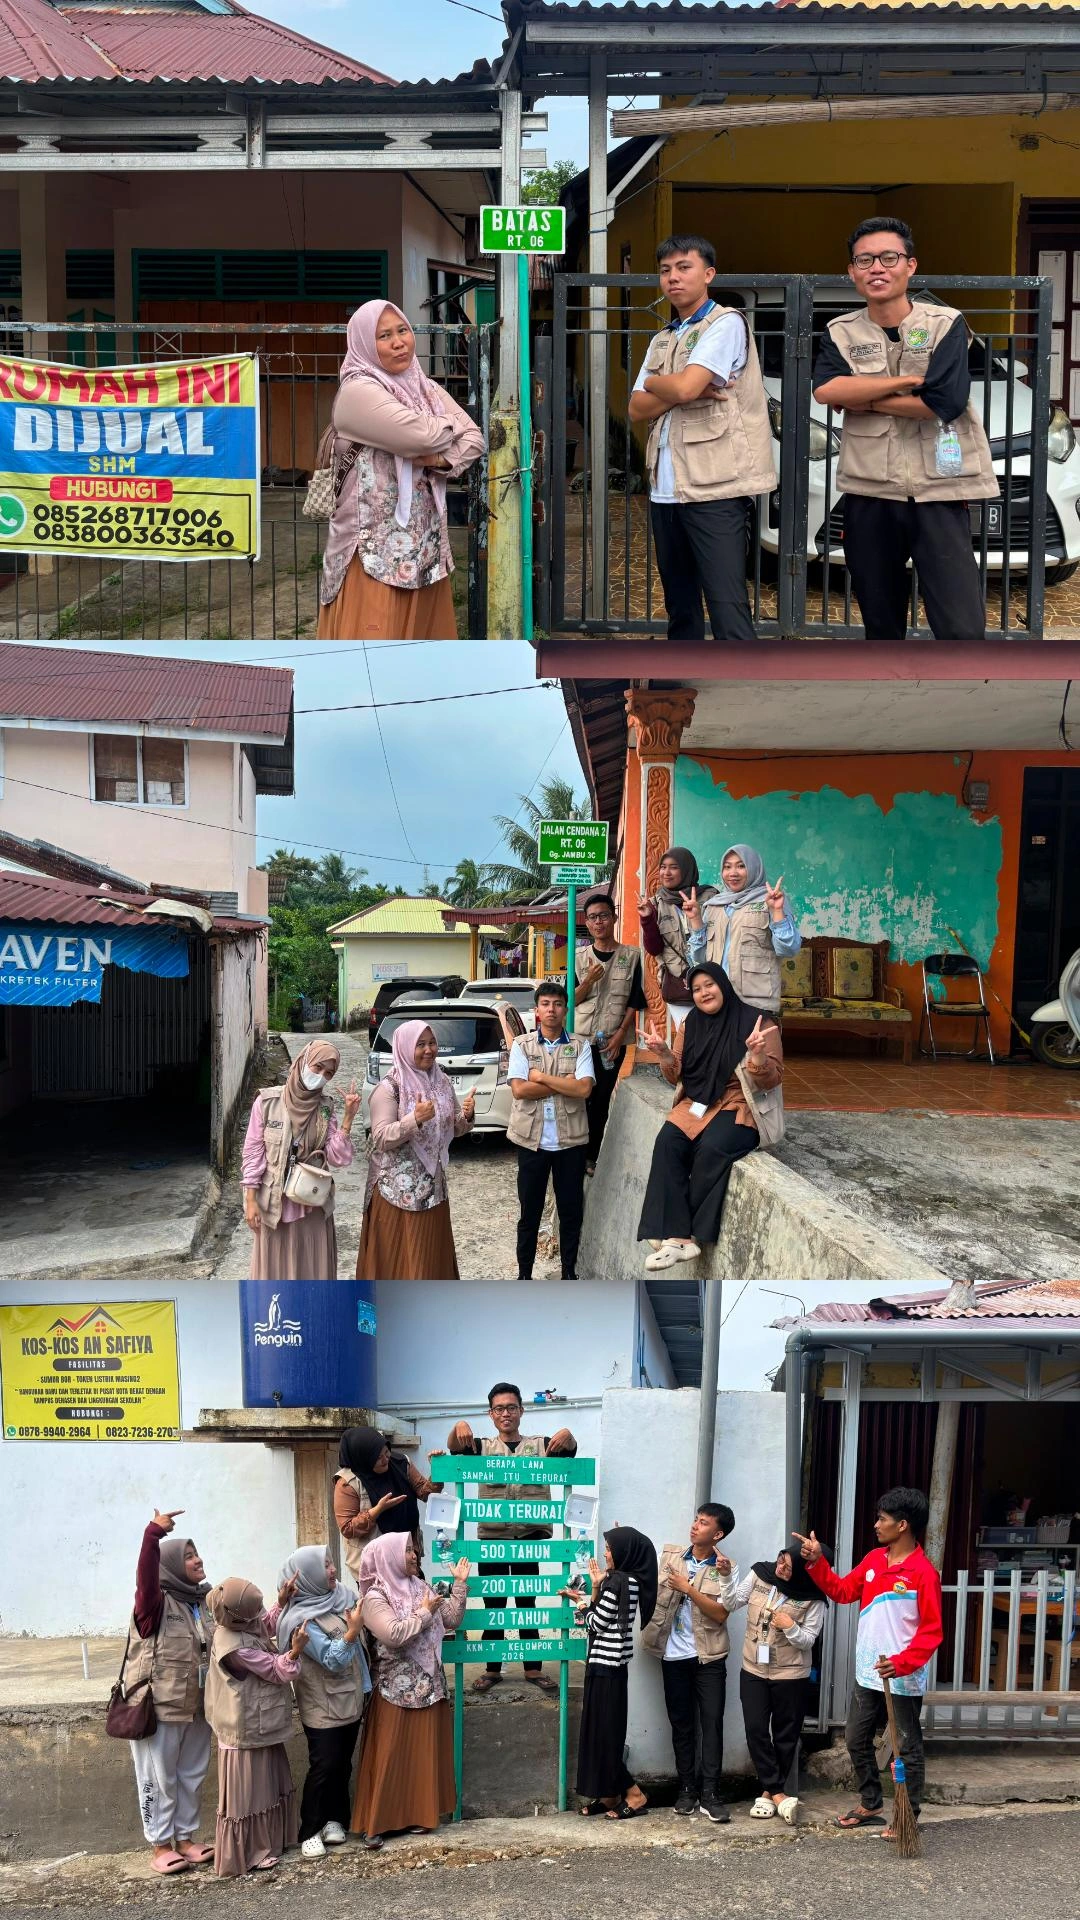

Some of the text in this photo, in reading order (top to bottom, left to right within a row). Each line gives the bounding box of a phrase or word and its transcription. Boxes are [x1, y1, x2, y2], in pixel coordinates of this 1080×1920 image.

[492, 210, 552, 232] BATAS
[507, 235, 544, 248] RT 06
[176, 362, 241, 404] INI
[13, 407, 215, 456] DIJUAL
[88, 455, 136, 474] SHM
[66, 479, 158, 499] HUBUNGI
[33, 503, 223, 529] 085268717006
[33, 522, 235, 548] 083800363540
[542, 825, 606, 837] JALAN CENDANA 2
[560, 838, 586, 849] RT. 06
[549, 850, 596, 859] Gg. JAMBU 3C
[0, 975, 98, 987] KRETEK FILTER
[21, 1335, 154, 1356] KOS-KOS AN SAFIYA
[254, 1331, 303, 1347] Penguin
[68, 1360, 106, 1369] FASILITAS
[71, 1409, 104, 1417] HUBUNGI
[19, 1426, 91, 1437] 0878-9940-2964
[486, 1459, 516, 1469] BERAPA
[462, 1471, 568, 1483] SAMPAH ITU TERURAI
[464, 1502, 563, 1520] TIDAK TERURAI
[480, 1544, 551, 1559] 500 TAHUN
[481, 1578, 551, 1594] 200 TAHUN
[488, 1610, 550, 1626] 20 TAHUN
[508, 1642, 552, 1651] KELOMPOK
[501, 1652, 525, 1661] 2026
